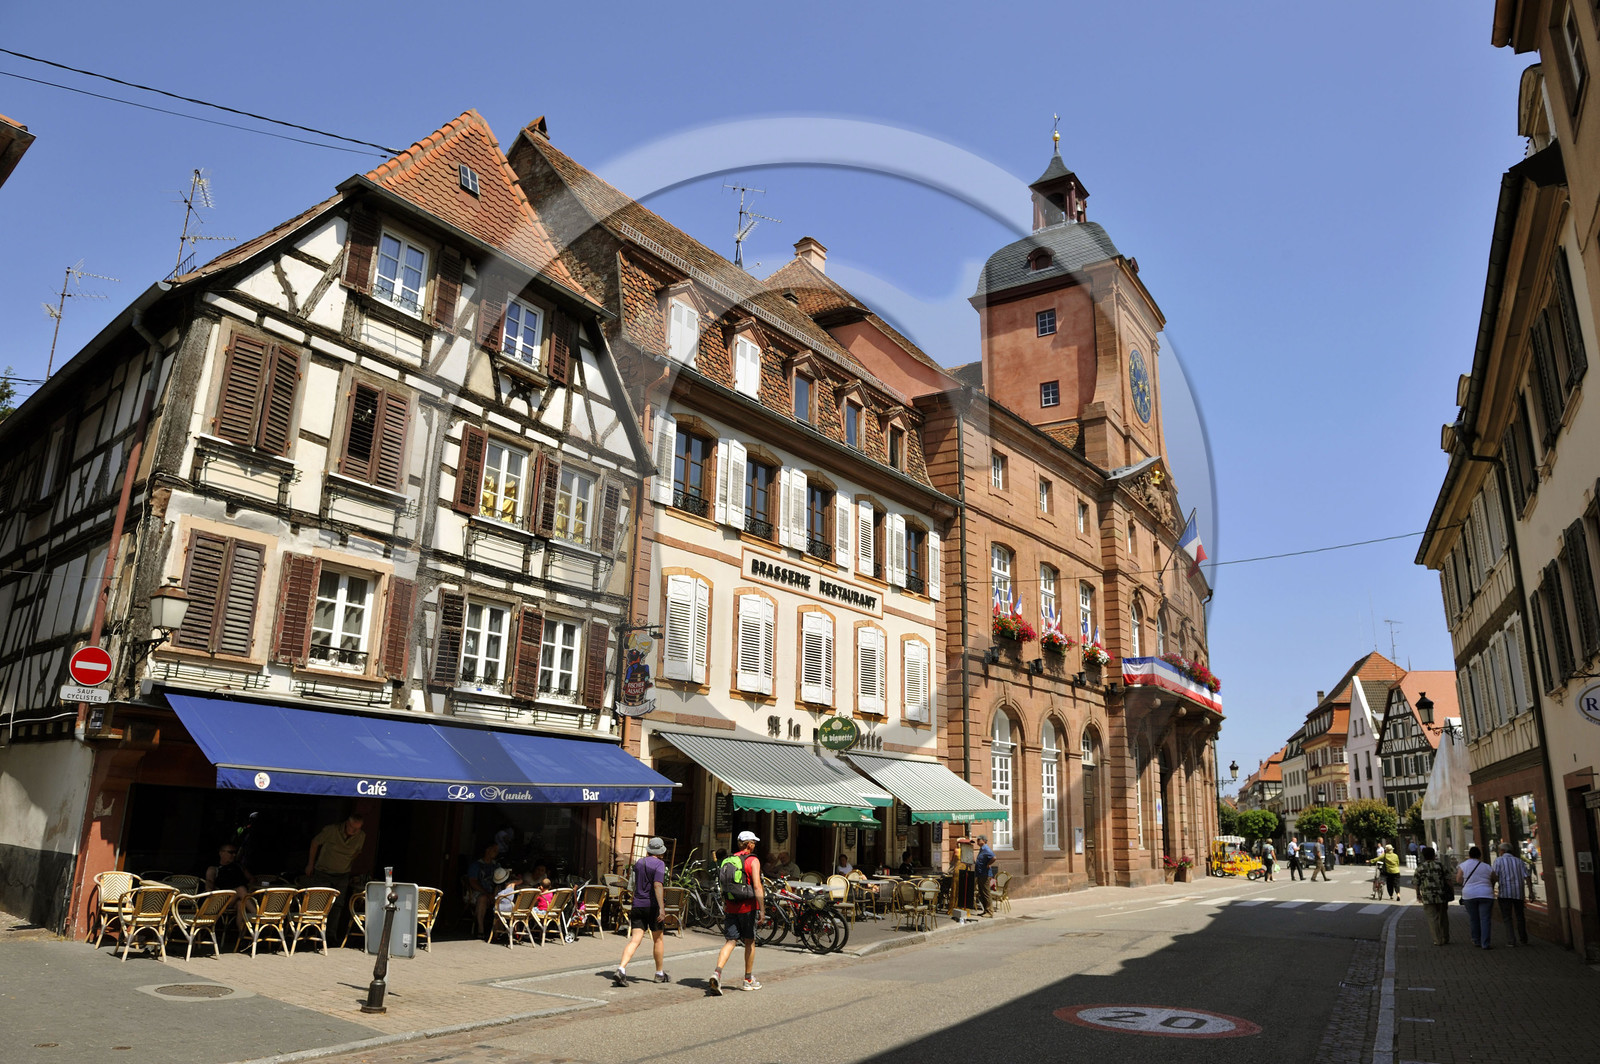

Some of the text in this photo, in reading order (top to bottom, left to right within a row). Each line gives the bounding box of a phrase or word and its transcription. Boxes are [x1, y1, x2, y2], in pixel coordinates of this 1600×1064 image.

[751, 558, 877, 609] BRASSERIE RESTAURANT
[67, 693, 102, 701] CYCLISTES
[786, 717, 802, 738] la
[821, 733, 853, 744] la vignette
[356, 780, 387, 797] Café
[447, 785, 533, 802] Le Munich
[582, 788, 600, 802] Bar
[951, 812, 976, 820] Restaurant
[1098, 1010, 1208, 1029] 20
